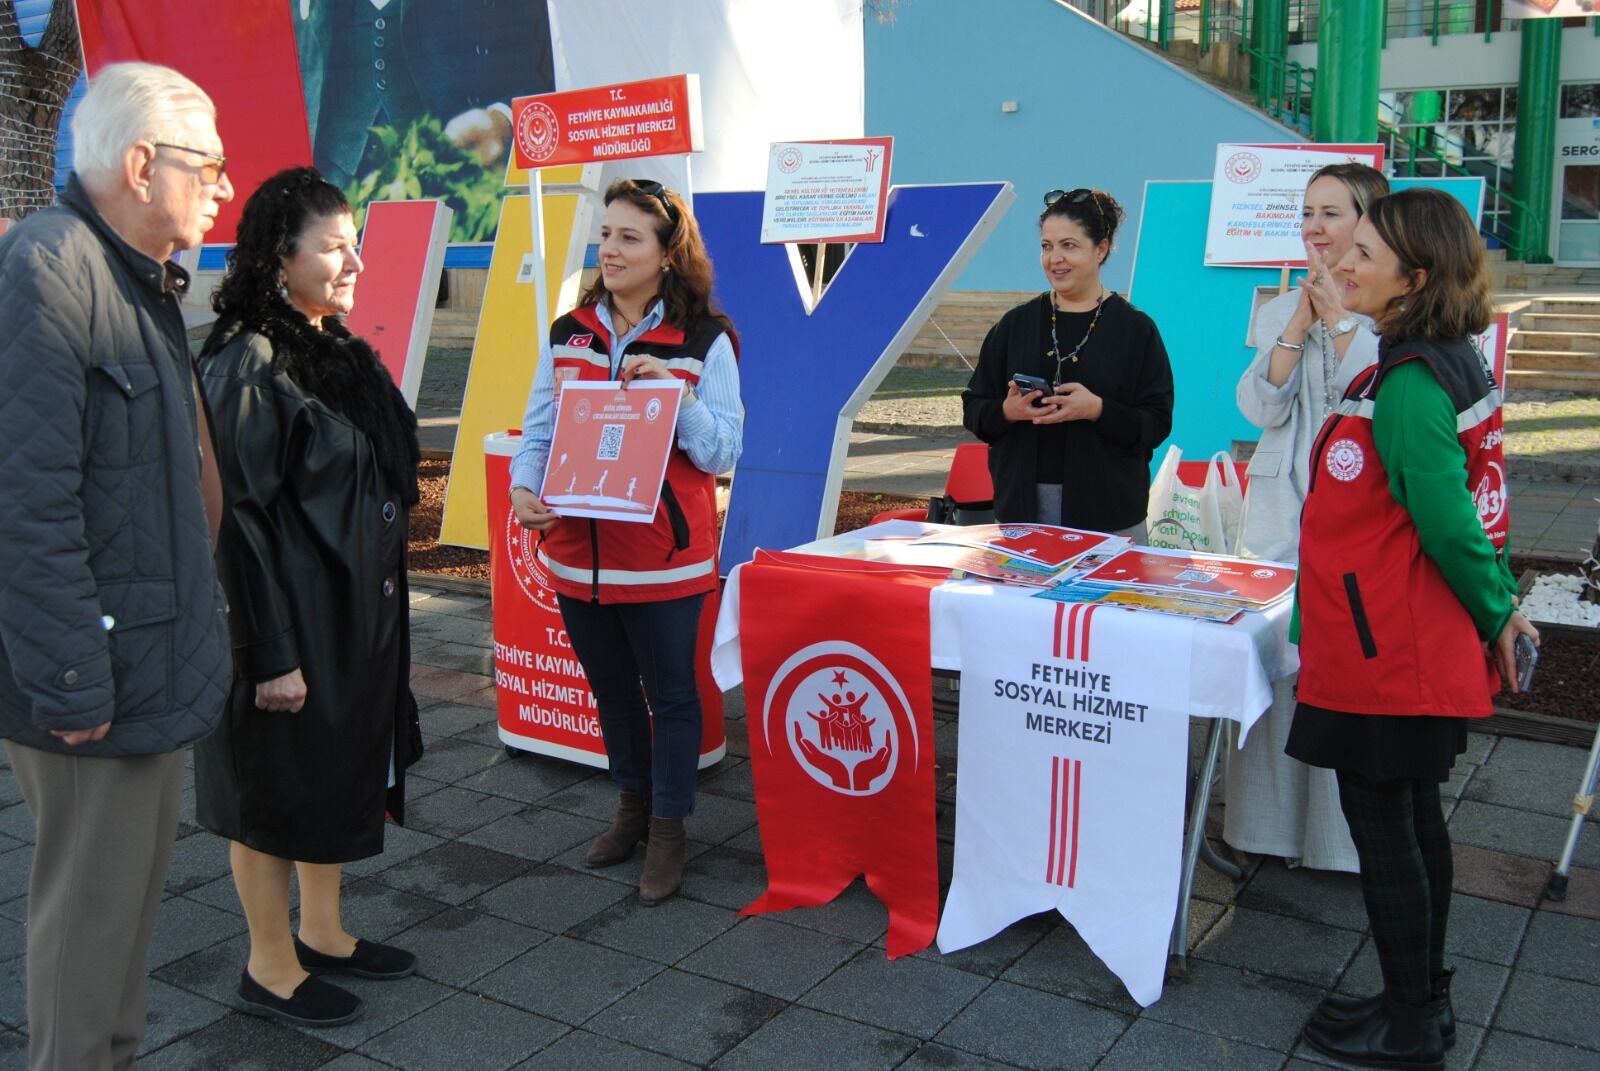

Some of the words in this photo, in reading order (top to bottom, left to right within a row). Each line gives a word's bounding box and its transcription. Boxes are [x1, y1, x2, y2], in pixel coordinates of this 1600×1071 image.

[609, 88, 626, 102] T.C.
[568, 108, 603, 125] FETHİYE
[604, 98, 673, 120] KAYMAKAMLIĞI
[567, 125, 600, 143] SOSYAL
[601, 121, 635, 139] HİZMET
[637, 116, 676, 134] MERKEZİ
[593, 137, 651, 157] MÜDÜRLÜĞÜ
[1255, 212, 1296, 220] BAKIMDAN
[1266, 202, 1299, 211] ZİHİNSEL
[546, 627, 571, 649] T.C.
[535, 654, 587, 680] KAYMA
[1031, 662, 1111, 692] FETHİYE
[532, 677, 584, 707] HİZMET
[994, 679, 1067, 709] SOSYAL
[1073, 690, 1149, 723] HİZMET
[1026, 712, 1112, 744] MERKEZİ
